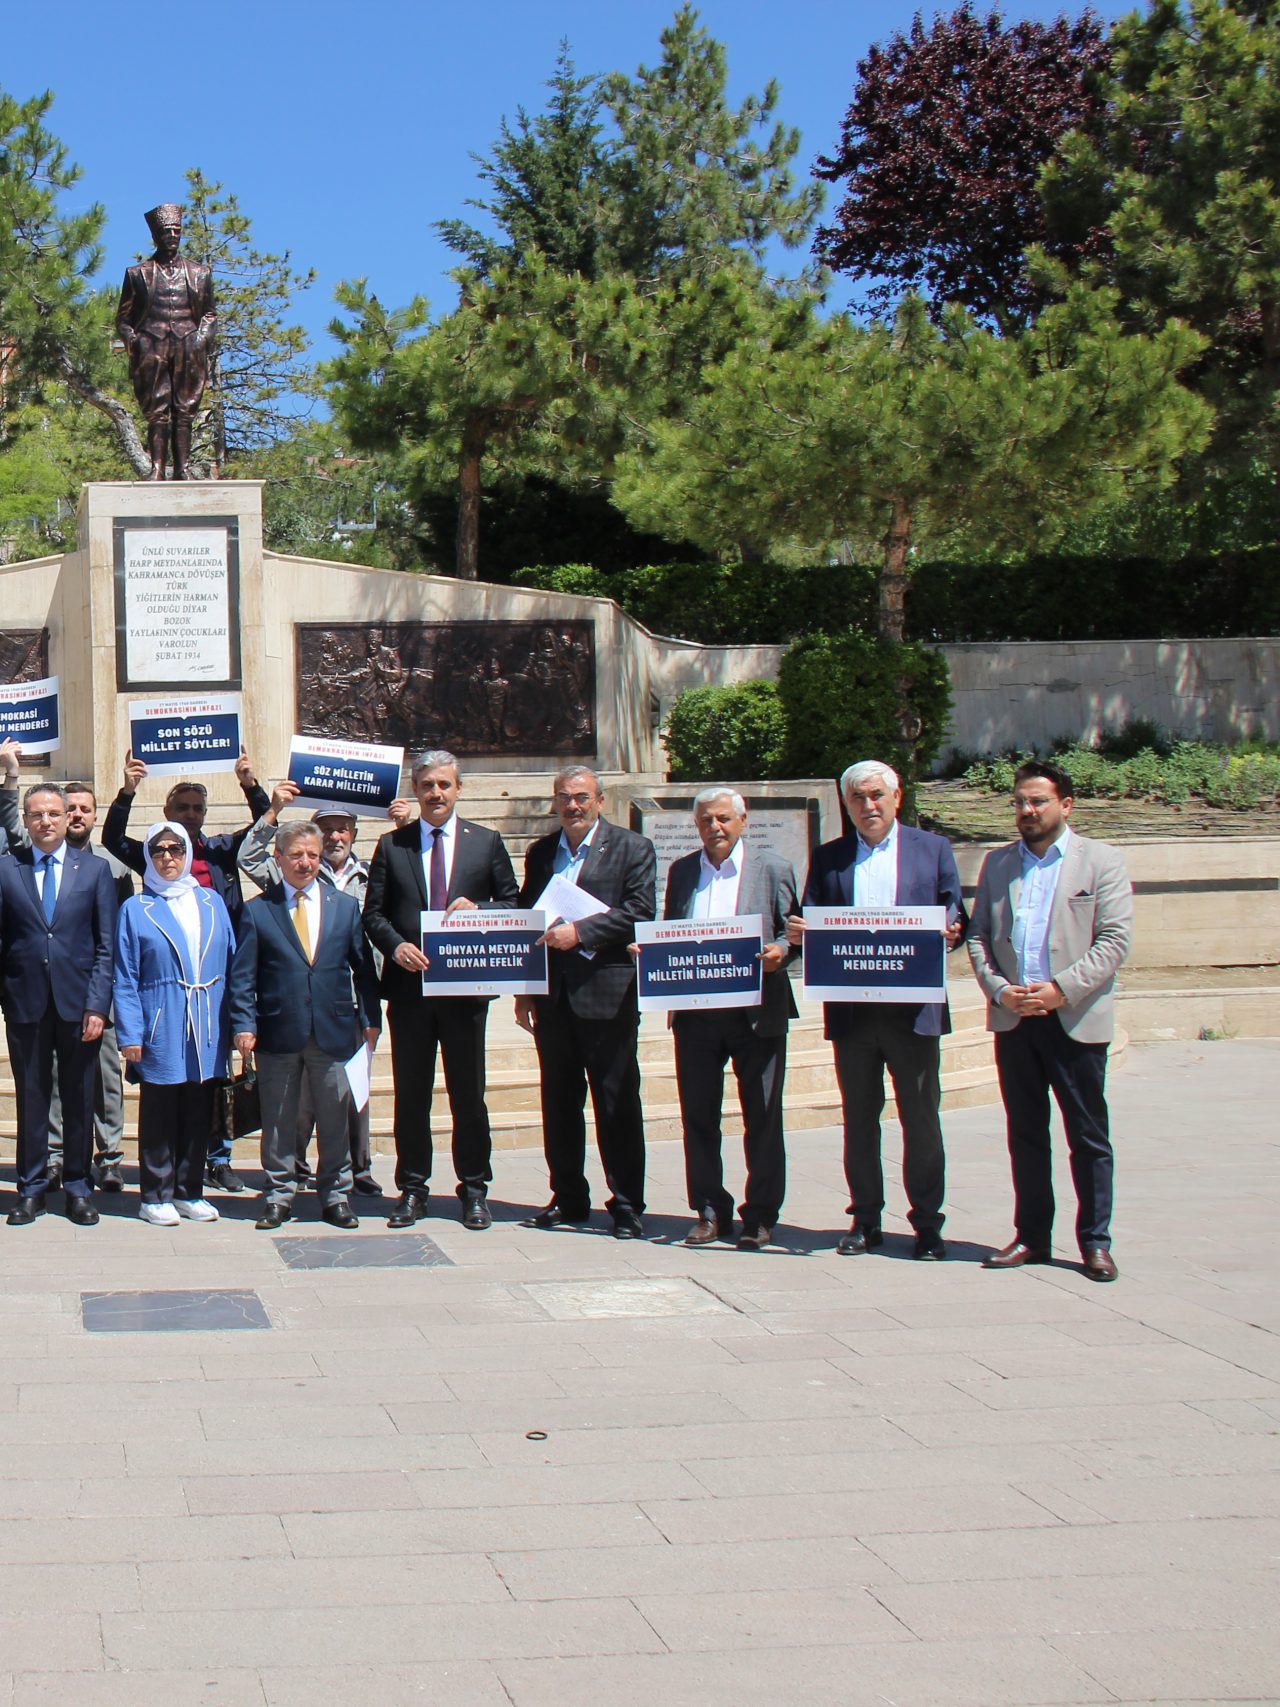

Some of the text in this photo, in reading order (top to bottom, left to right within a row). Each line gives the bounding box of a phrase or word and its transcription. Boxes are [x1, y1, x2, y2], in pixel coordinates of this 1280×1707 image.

[129, 559, 223, 567] HARP MEYDANLARINDA
[128, 571, 185, 579] KAHRAMANCA
[183, 593, 219, 601] HARMAN
[163, 617, 191, 625] BOZOK
[179, 628, 226, 638] ÇOCUKLARI
[159, 640, 198, 648] VAROLUN
[7, 719, 49, 732] MENDERES
[157, 724, 213, 738] SON SÖZÜ
[141, 738, 230, 753] MİLLET SÖYLER!
[313, 765, 374, 782] SÖZ MİLLETİN
[304, 776, 381, 795] KARAR MİLLETİN!
[438, 943, 530, 956] DÜNYAYA MEYDAN
[832, 945, 915, 956] HALKIN ADAMI
[446, 955, 523, 968] OKUYAN EFELİK
[668, 952, 732, 967] İDAM EDİLEN
[843, 960, 904, 971] MENDERES
[648, 964, 753, 982] MİLLETİN İRADESİYDİ
